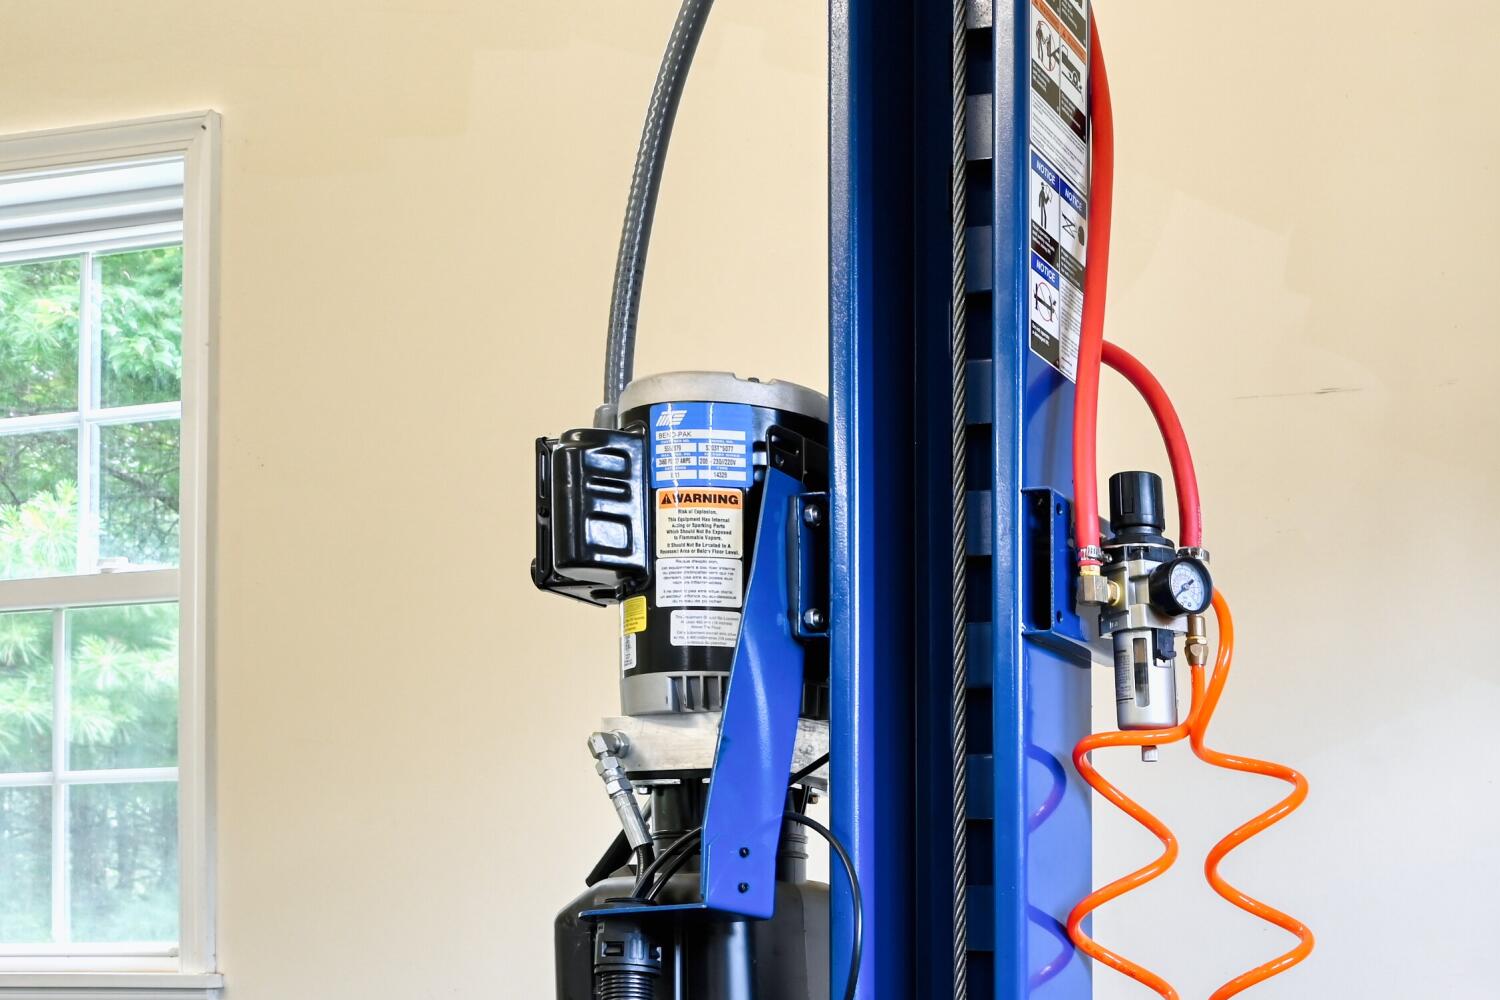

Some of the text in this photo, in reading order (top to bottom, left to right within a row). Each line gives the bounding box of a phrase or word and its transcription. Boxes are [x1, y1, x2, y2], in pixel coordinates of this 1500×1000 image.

[1036, 160, 1056, 186] NOTICE
[1065, 188, 1082, 211] NOTICE
[1036, 259, 1056, 283] NOTICE
[672, 494, 738, 504] WARNING
